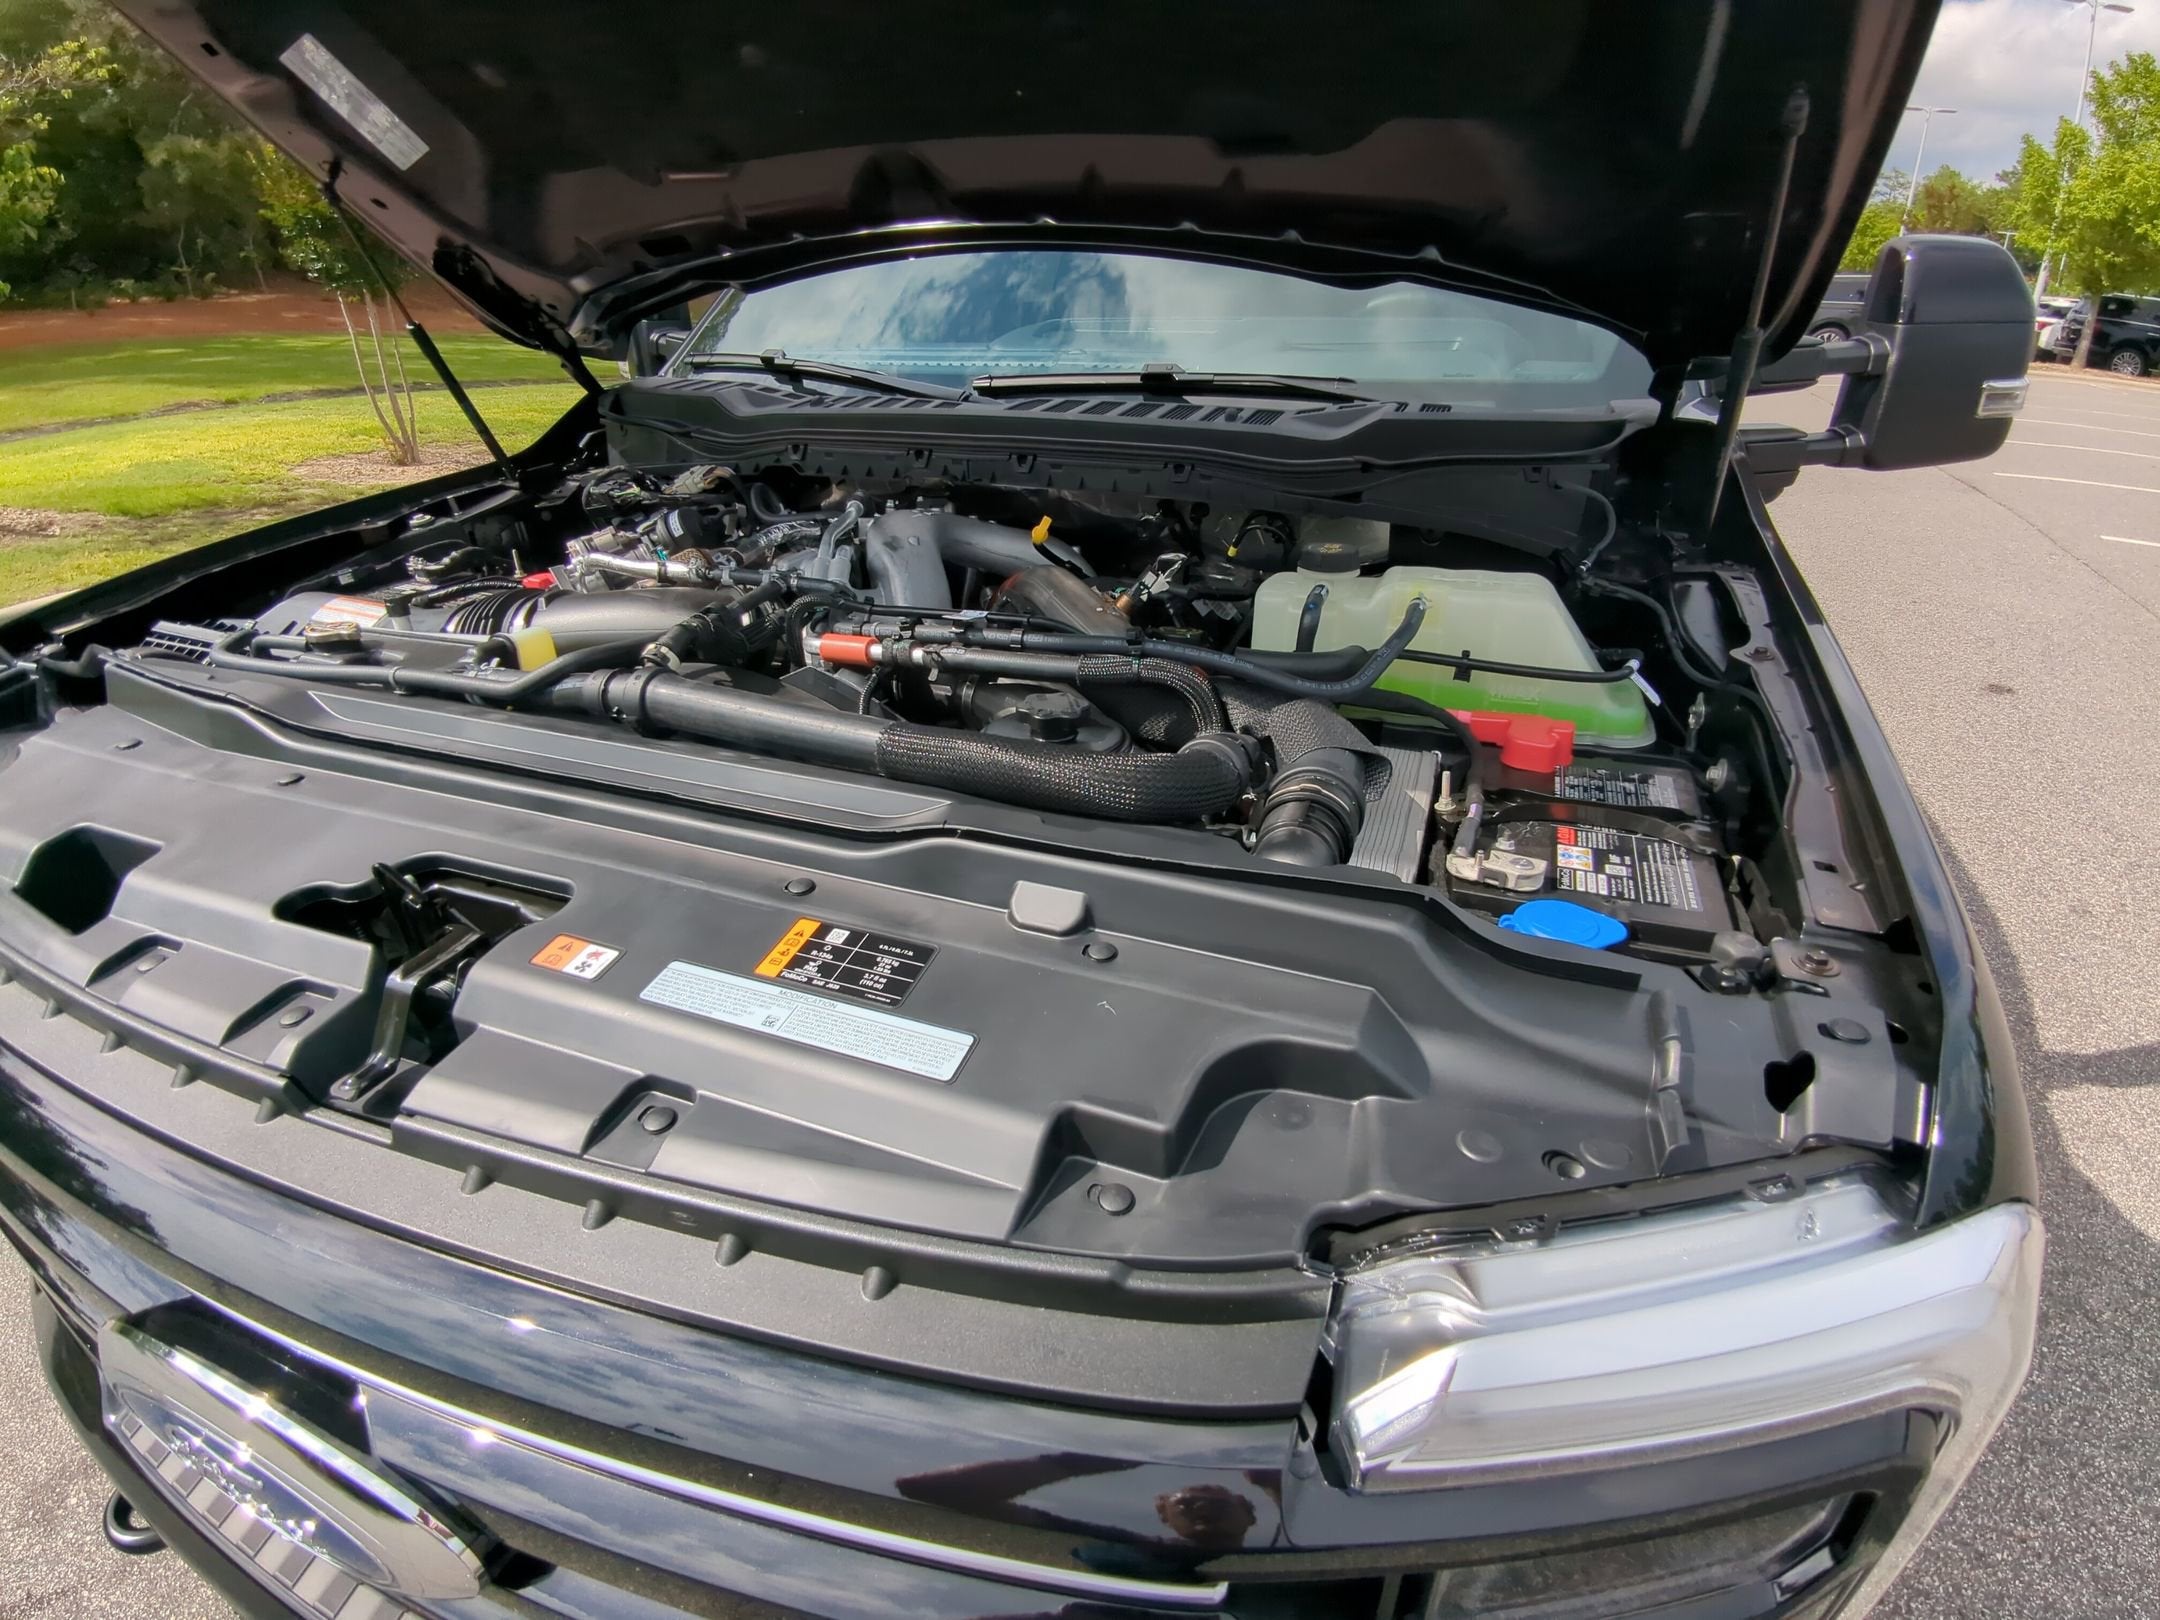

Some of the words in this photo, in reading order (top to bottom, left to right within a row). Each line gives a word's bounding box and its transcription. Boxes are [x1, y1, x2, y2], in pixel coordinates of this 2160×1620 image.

[1560, 868, 1571, 889] FoMoCo
[810, 950, 833, 959] R-134a
[780, 971, 808, 982] FoMoCo
[778, 989, 838, 1010] MODIFICATION
